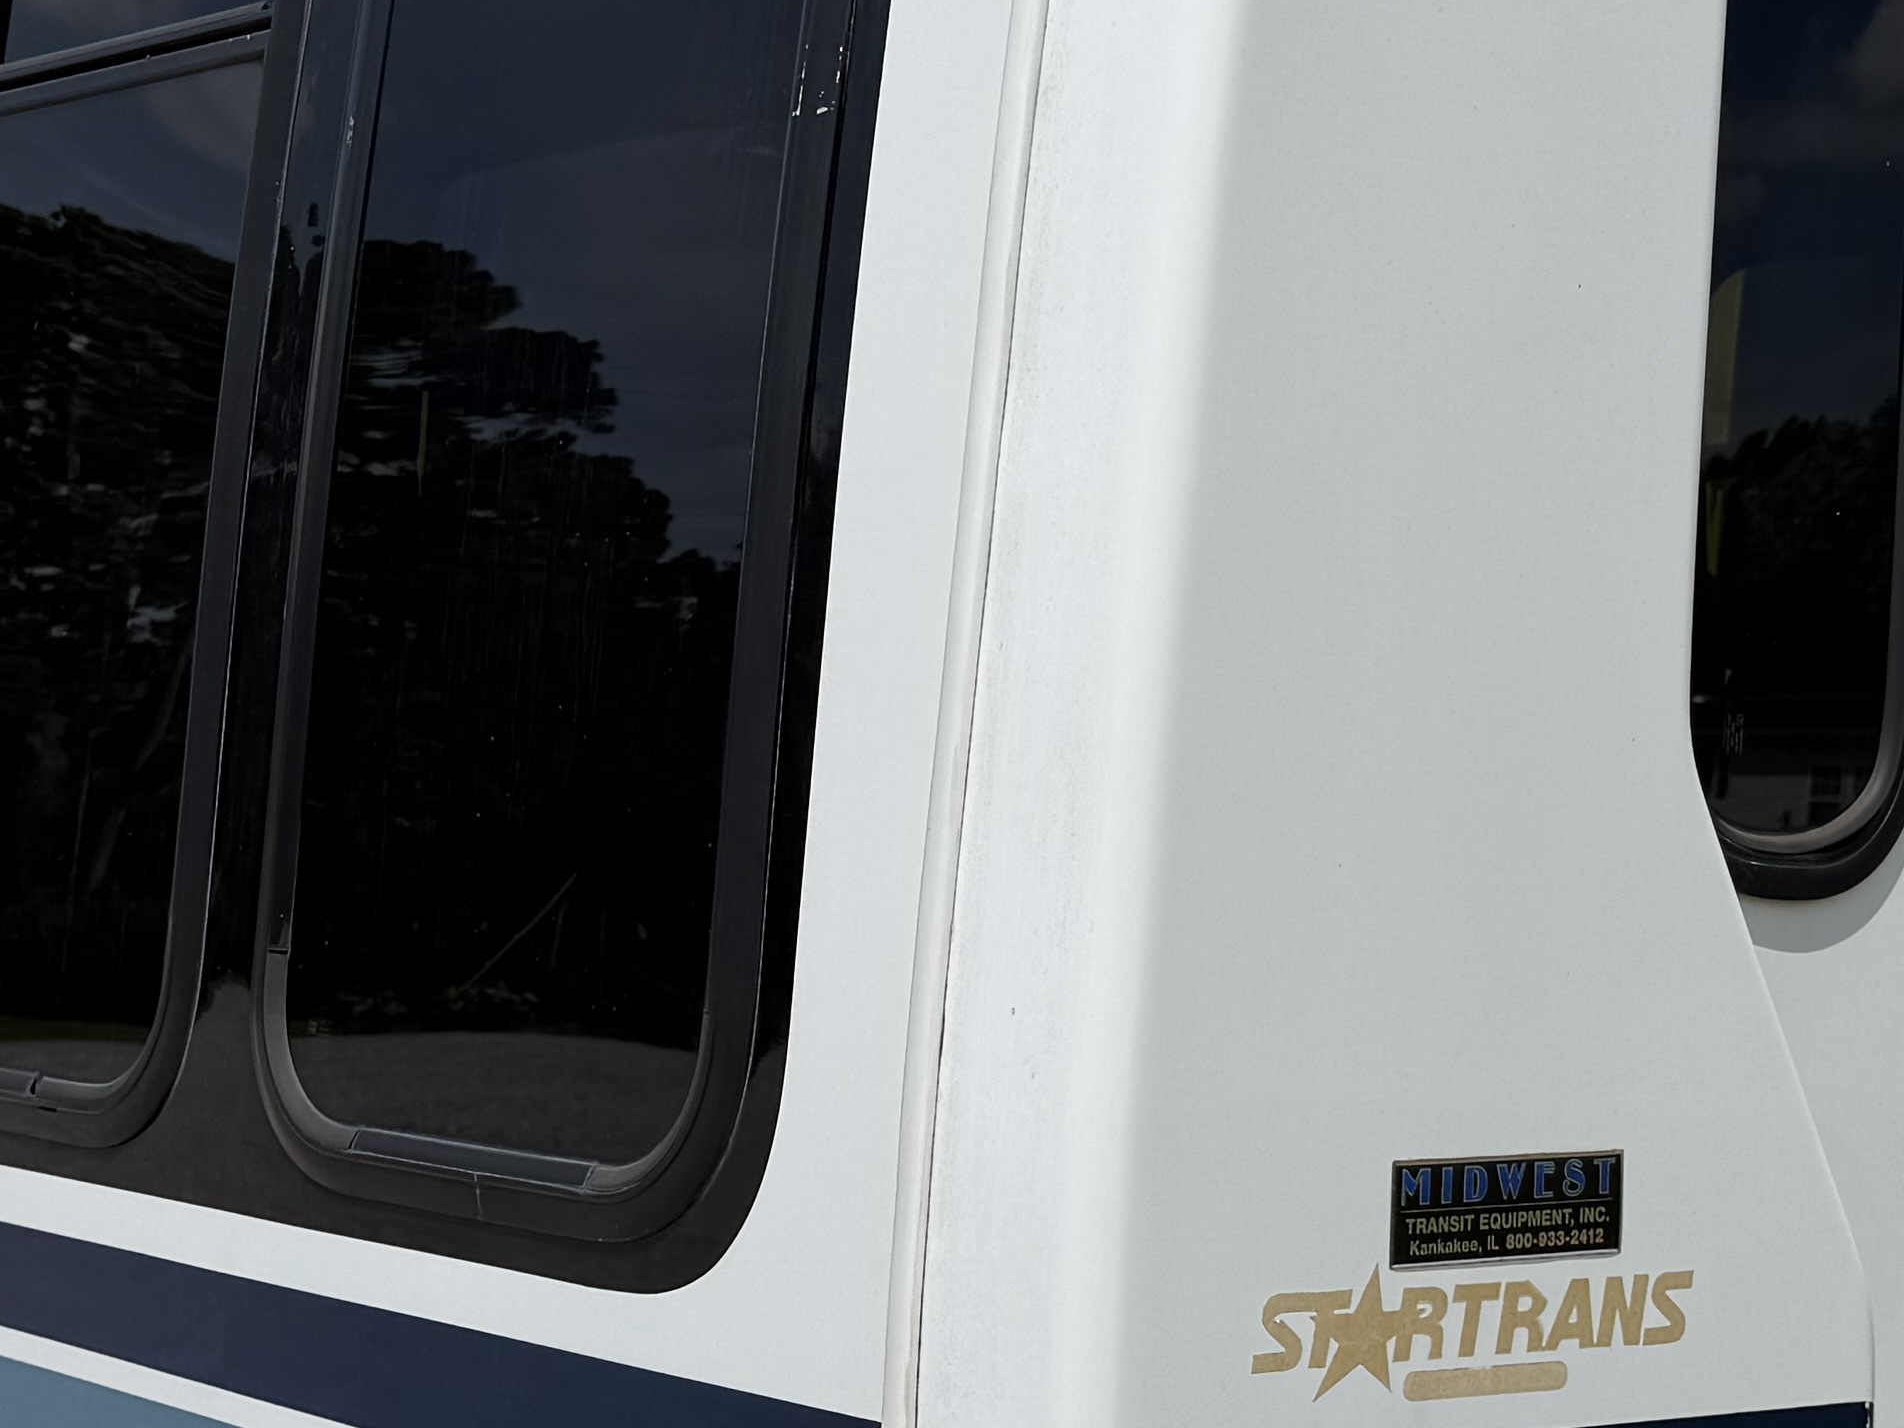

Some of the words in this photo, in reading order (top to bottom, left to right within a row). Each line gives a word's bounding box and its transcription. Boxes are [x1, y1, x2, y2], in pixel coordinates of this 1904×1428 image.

[1401, 1158, 1616, 1206] MIDWEST
[1406, 1214, 1474, 1235] TRANSIT
[1480, 1208, 1575, 1230] EQUIPMENT,
[1580, 1206, 1610, 1224] INC.
[1410, 1238, 1482, 1256] Kankakee,
[1487, 1235, 1499, 1251] IL
